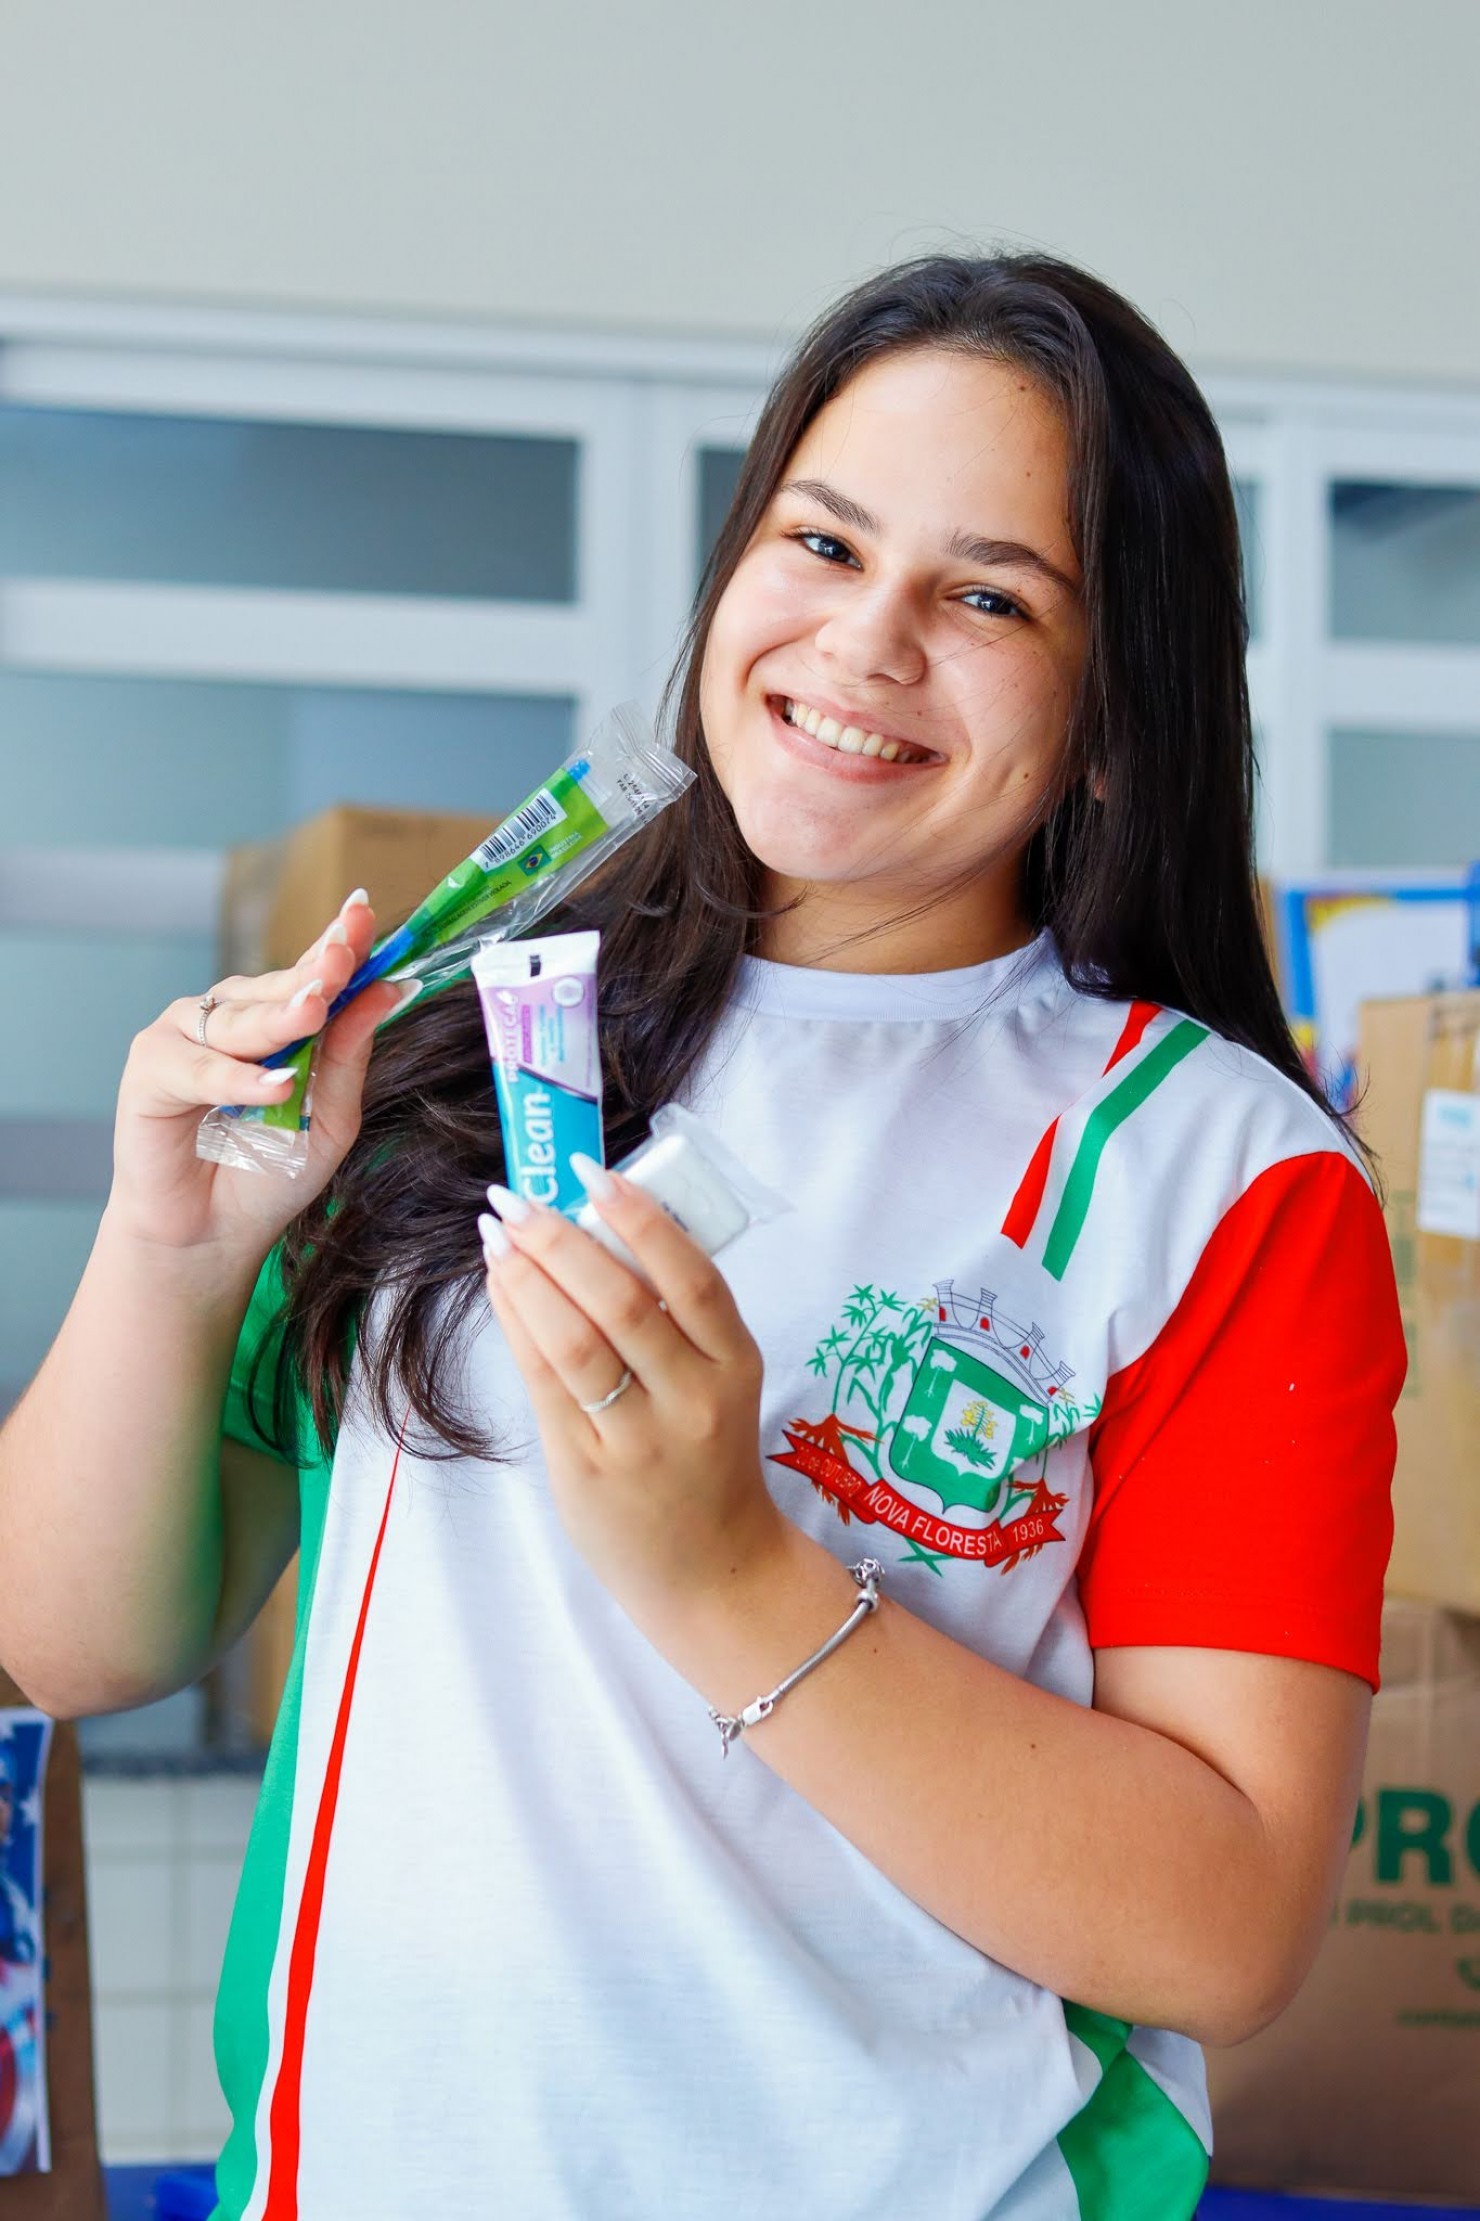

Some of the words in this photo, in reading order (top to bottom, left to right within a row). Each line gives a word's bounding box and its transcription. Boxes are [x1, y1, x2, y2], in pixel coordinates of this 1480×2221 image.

[494, 838, 525, 864] 898646
[526, 814, 557, 840] 690074
[521, 1092, 558, 1201] Clean
[819, 1458, 863, 1498] OUTUBRO
[864, 1485, 907, 1529] NOVA
[911, 1519, 1002, 1555] FLORESTA
[1012, 1520, 1044, 1542] 1936
